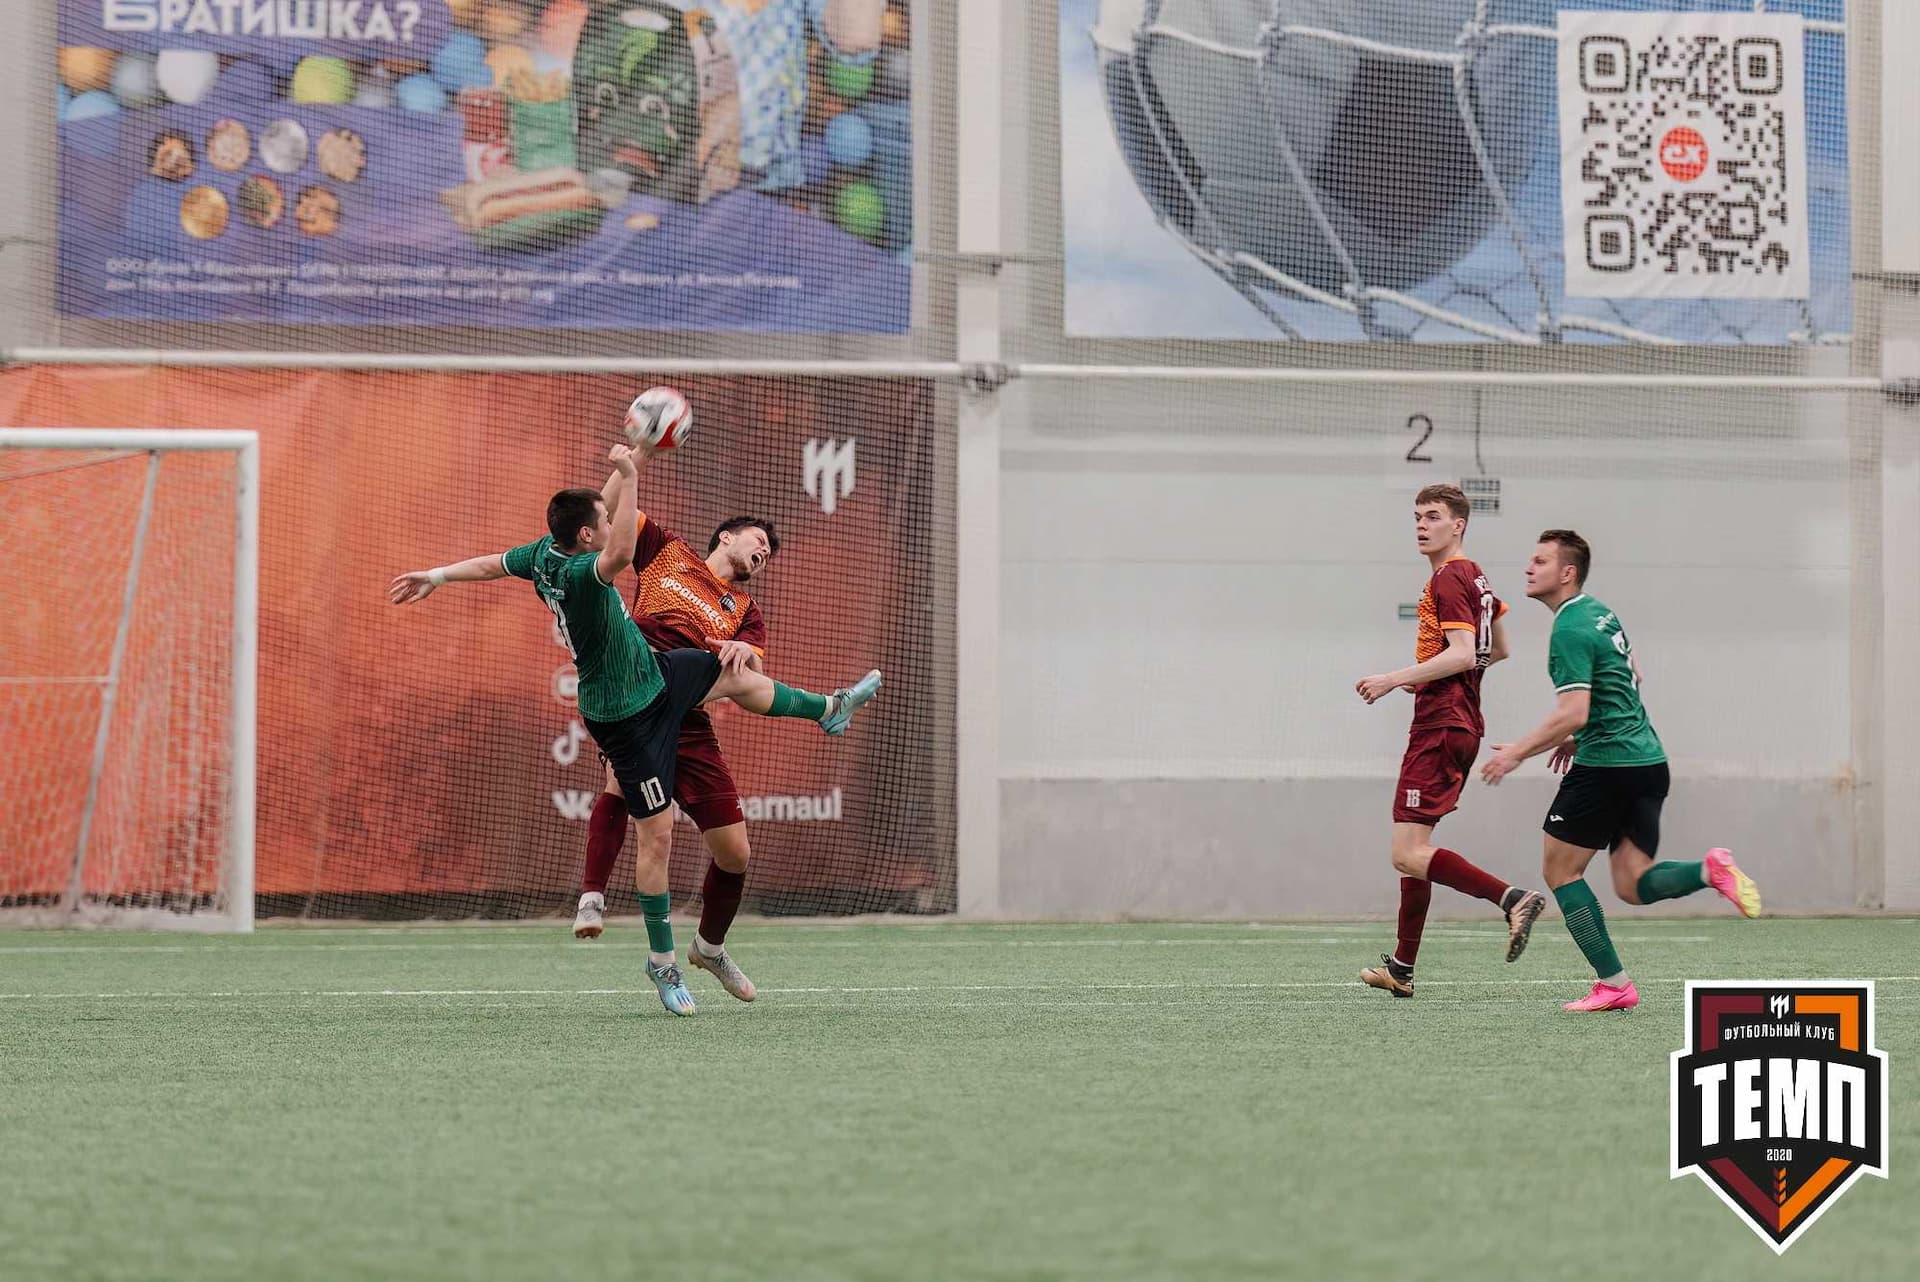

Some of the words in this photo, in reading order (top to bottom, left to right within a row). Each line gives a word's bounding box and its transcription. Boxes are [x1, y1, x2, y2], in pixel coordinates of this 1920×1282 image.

[103, 0, 421, 41] БРАТИШКА?
[1406, 414, 1432, 463] 2
[640, 776, 666, 811] 10
[1405, 789, 1421, 808] 18
